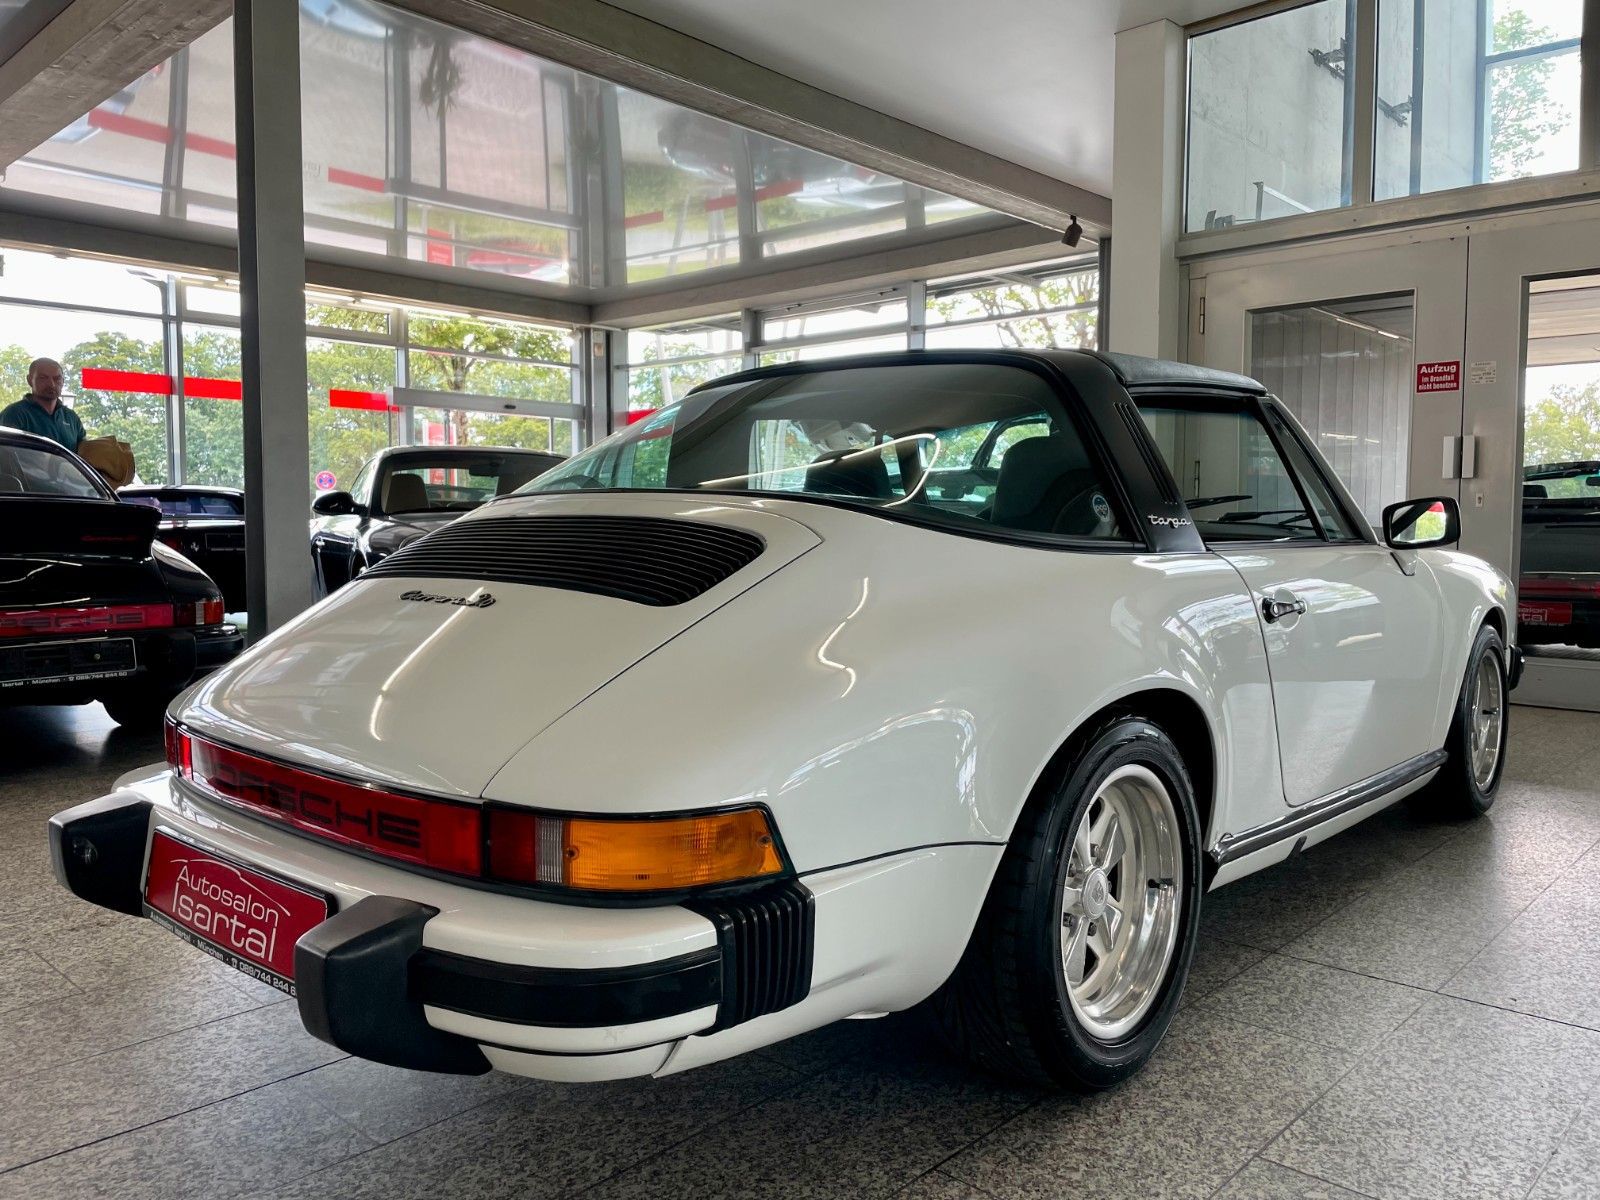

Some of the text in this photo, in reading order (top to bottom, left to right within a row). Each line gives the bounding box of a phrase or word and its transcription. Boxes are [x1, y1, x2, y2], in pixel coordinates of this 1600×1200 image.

[1420, 365, 1457, 374] Aufzug
[1429, 374, 1455, 382] Brandfall
[1418, 382, 1432, 390] nicht
[1148, 514, 1192, 528] targa
[177, 865, 279, 927] Autosalon
[172, 882, 277, 962] Isartal
[197, 939, 224, 961] München
[273, 977, 289, 993] 244
